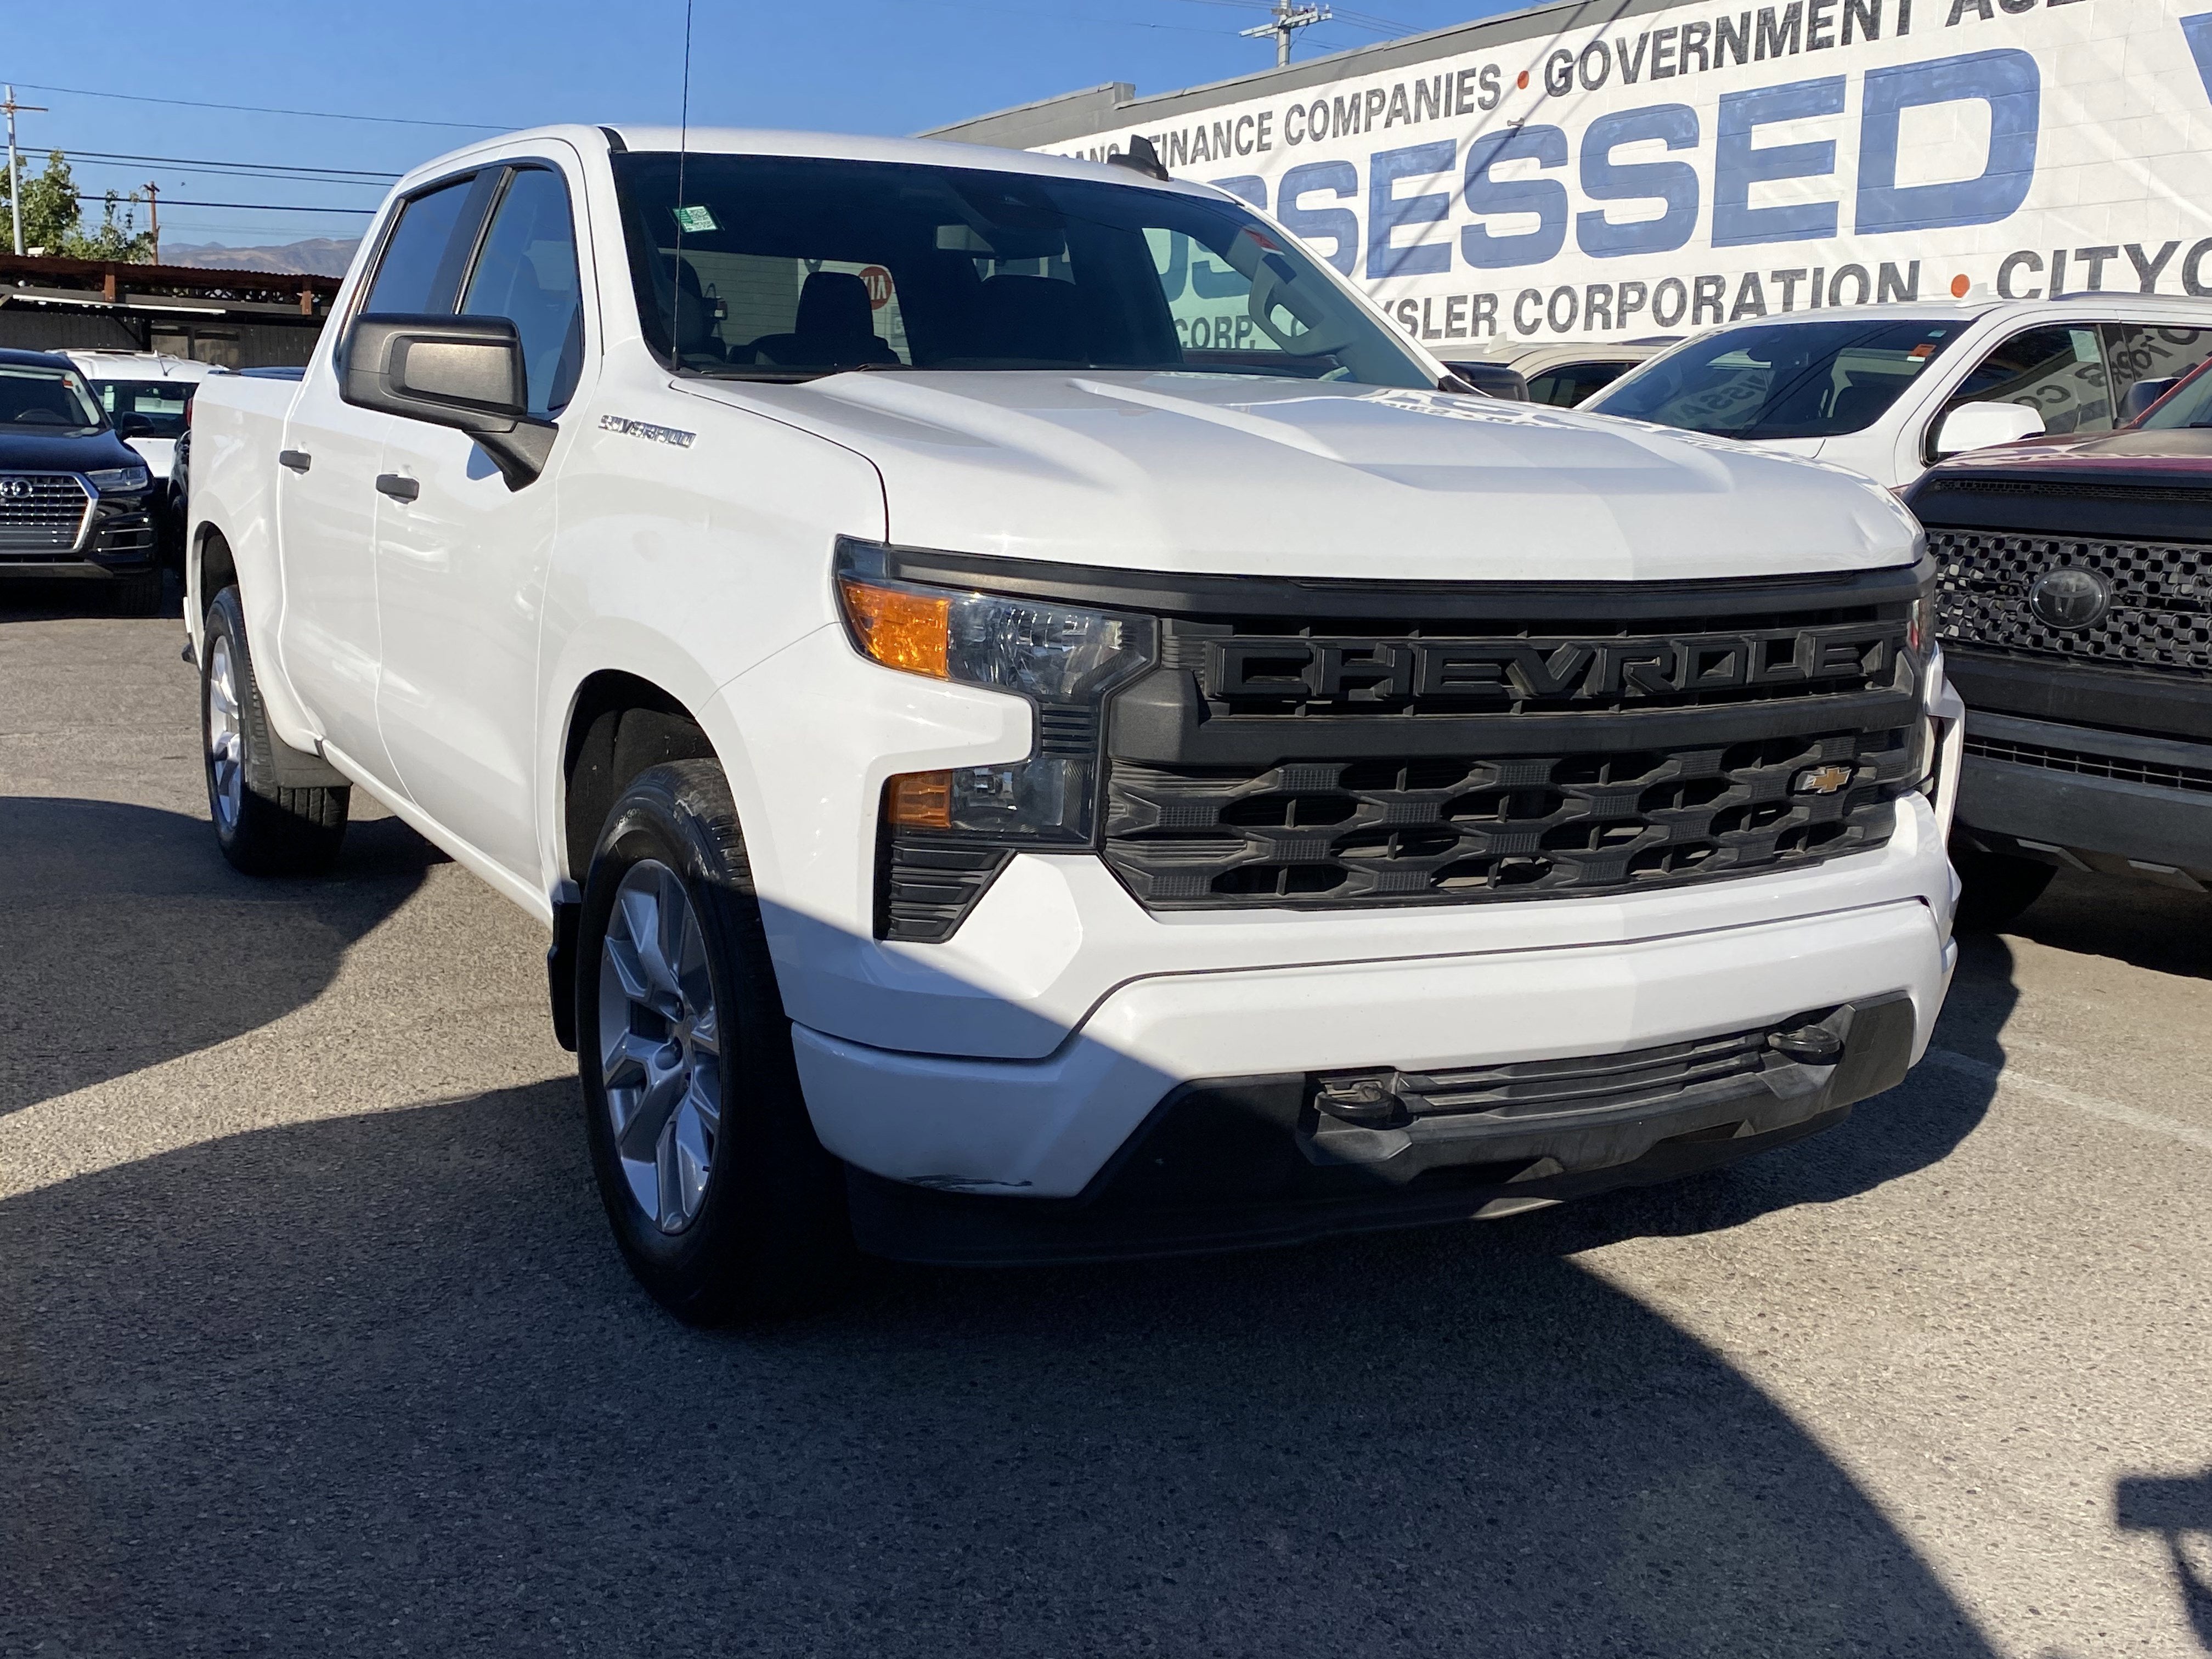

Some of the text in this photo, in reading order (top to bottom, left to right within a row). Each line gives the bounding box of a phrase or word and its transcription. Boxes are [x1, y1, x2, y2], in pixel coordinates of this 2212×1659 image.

[1284, 63, 1501, 147] COMPANIES
[1514, 259, 1920, 336] CORPORATION
[1214, 625, 1908, 699] CHEVROLET
